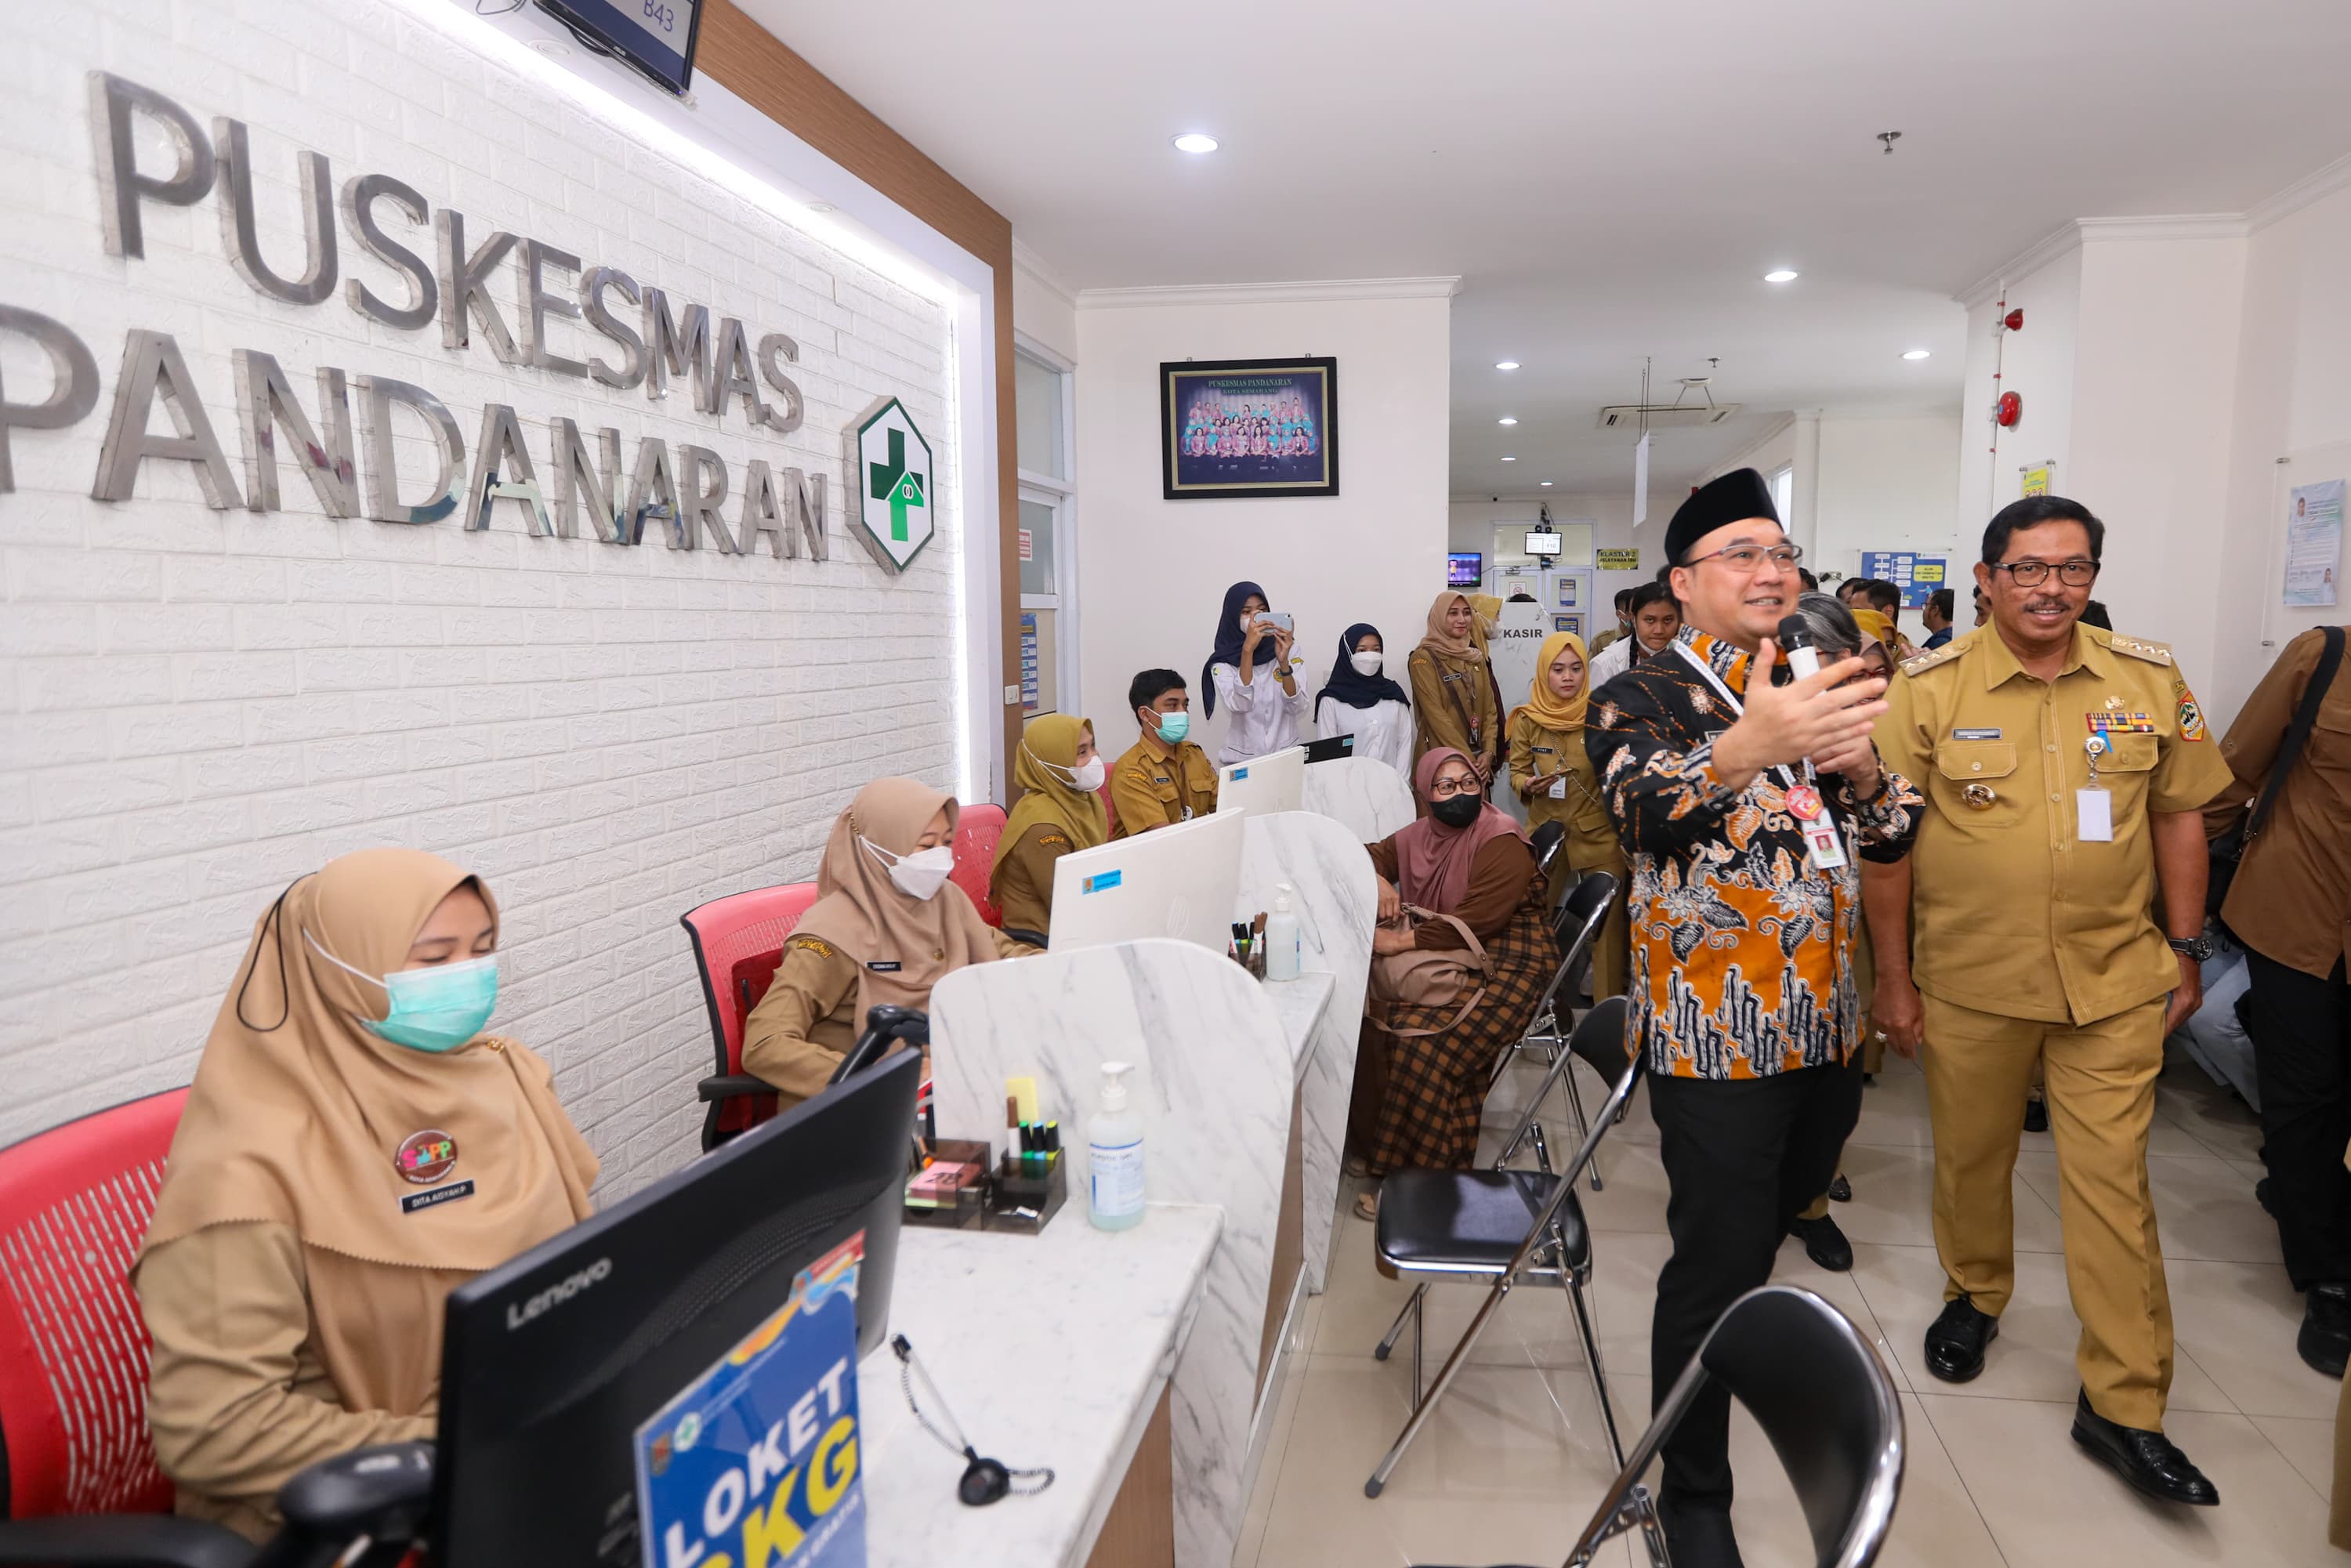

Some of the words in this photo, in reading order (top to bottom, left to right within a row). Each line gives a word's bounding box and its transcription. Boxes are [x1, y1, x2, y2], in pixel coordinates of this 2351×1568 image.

[643, 0, 674, 32] B43
[87, 69, 804, 433] PUSKESMAS
[0, 303, 829, 561] PANDANARAN
[1208, 379, 1247, 388] PUSKESMAS
[1248, 378, 1292, 387] PANDANARAN
[1503, 628, 1543, 638] KASIR
[506, 1256, 613, 1331] Lenovo
[665, 1356, 848, 1568] LOKET
[696, 1414, 857, 1568] KG
